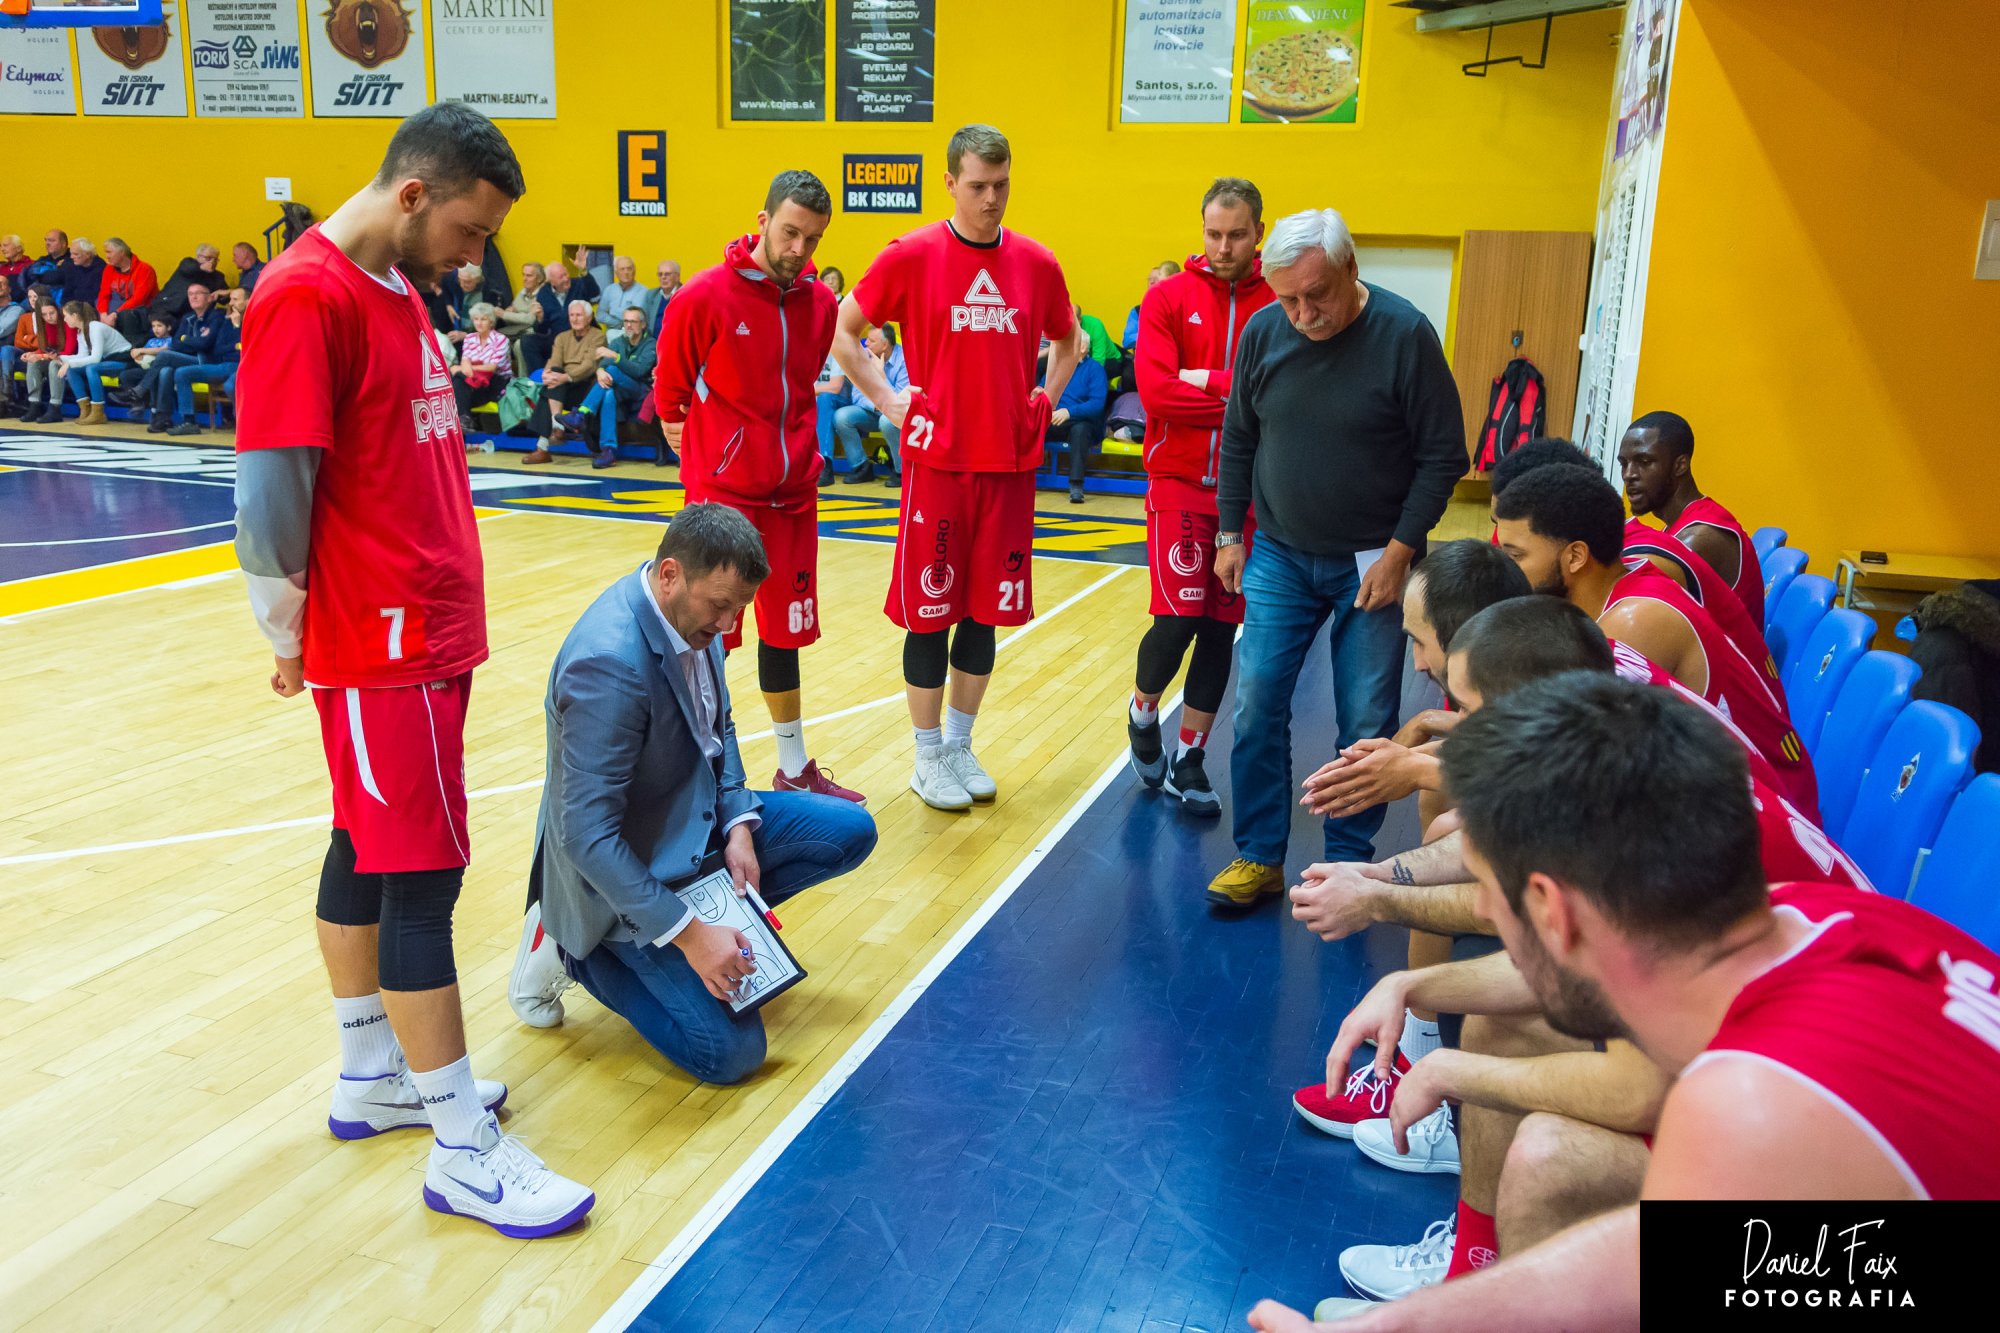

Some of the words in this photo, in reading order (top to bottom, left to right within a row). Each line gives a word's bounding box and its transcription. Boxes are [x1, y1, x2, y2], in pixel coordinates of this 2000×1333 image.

[443, 0, 545, 18] MARTINI
[852, 11, 920, 19] PROSTRIEDKOV
[1139, 8, 1222, 20] automatizácia
[445, 25, 482, 34] CENTER
[487, 25, 499, 34] OF
[505, 25, 543, 34] BEAUTY
[194, 50, 228, 65] TORK
[233, 60, 259, 70] SCA
[6, 64, 64, 86] Edymax
[1135, 79, 1184, 91] Santos,
[1187, 80, 1218, 90] s.r.o.
[739, 101, 816, 111] www.tajes.sk
[893, 94, 913, 103] PVC
[627, 134, 659, 200] E
[846, 163, 919, 185] LEGENDY
[620, 201, 666, 215] SEKTOR
[847, 192, 868, 207] BK
[871, 192, 917, 208] ISKRA
[951, 305, 1019, 334] PEAK
[907, 414, 935, 451] 21
[933, 518, 951, 583] HELORO
[997, 579, 1026, 612] 21
[788, 597, 815, 634] 63
[379, 606, 406, 660] 7
[343, 1012, 389, 1029] adidas
[422, 1091, 456, 1105] didas
